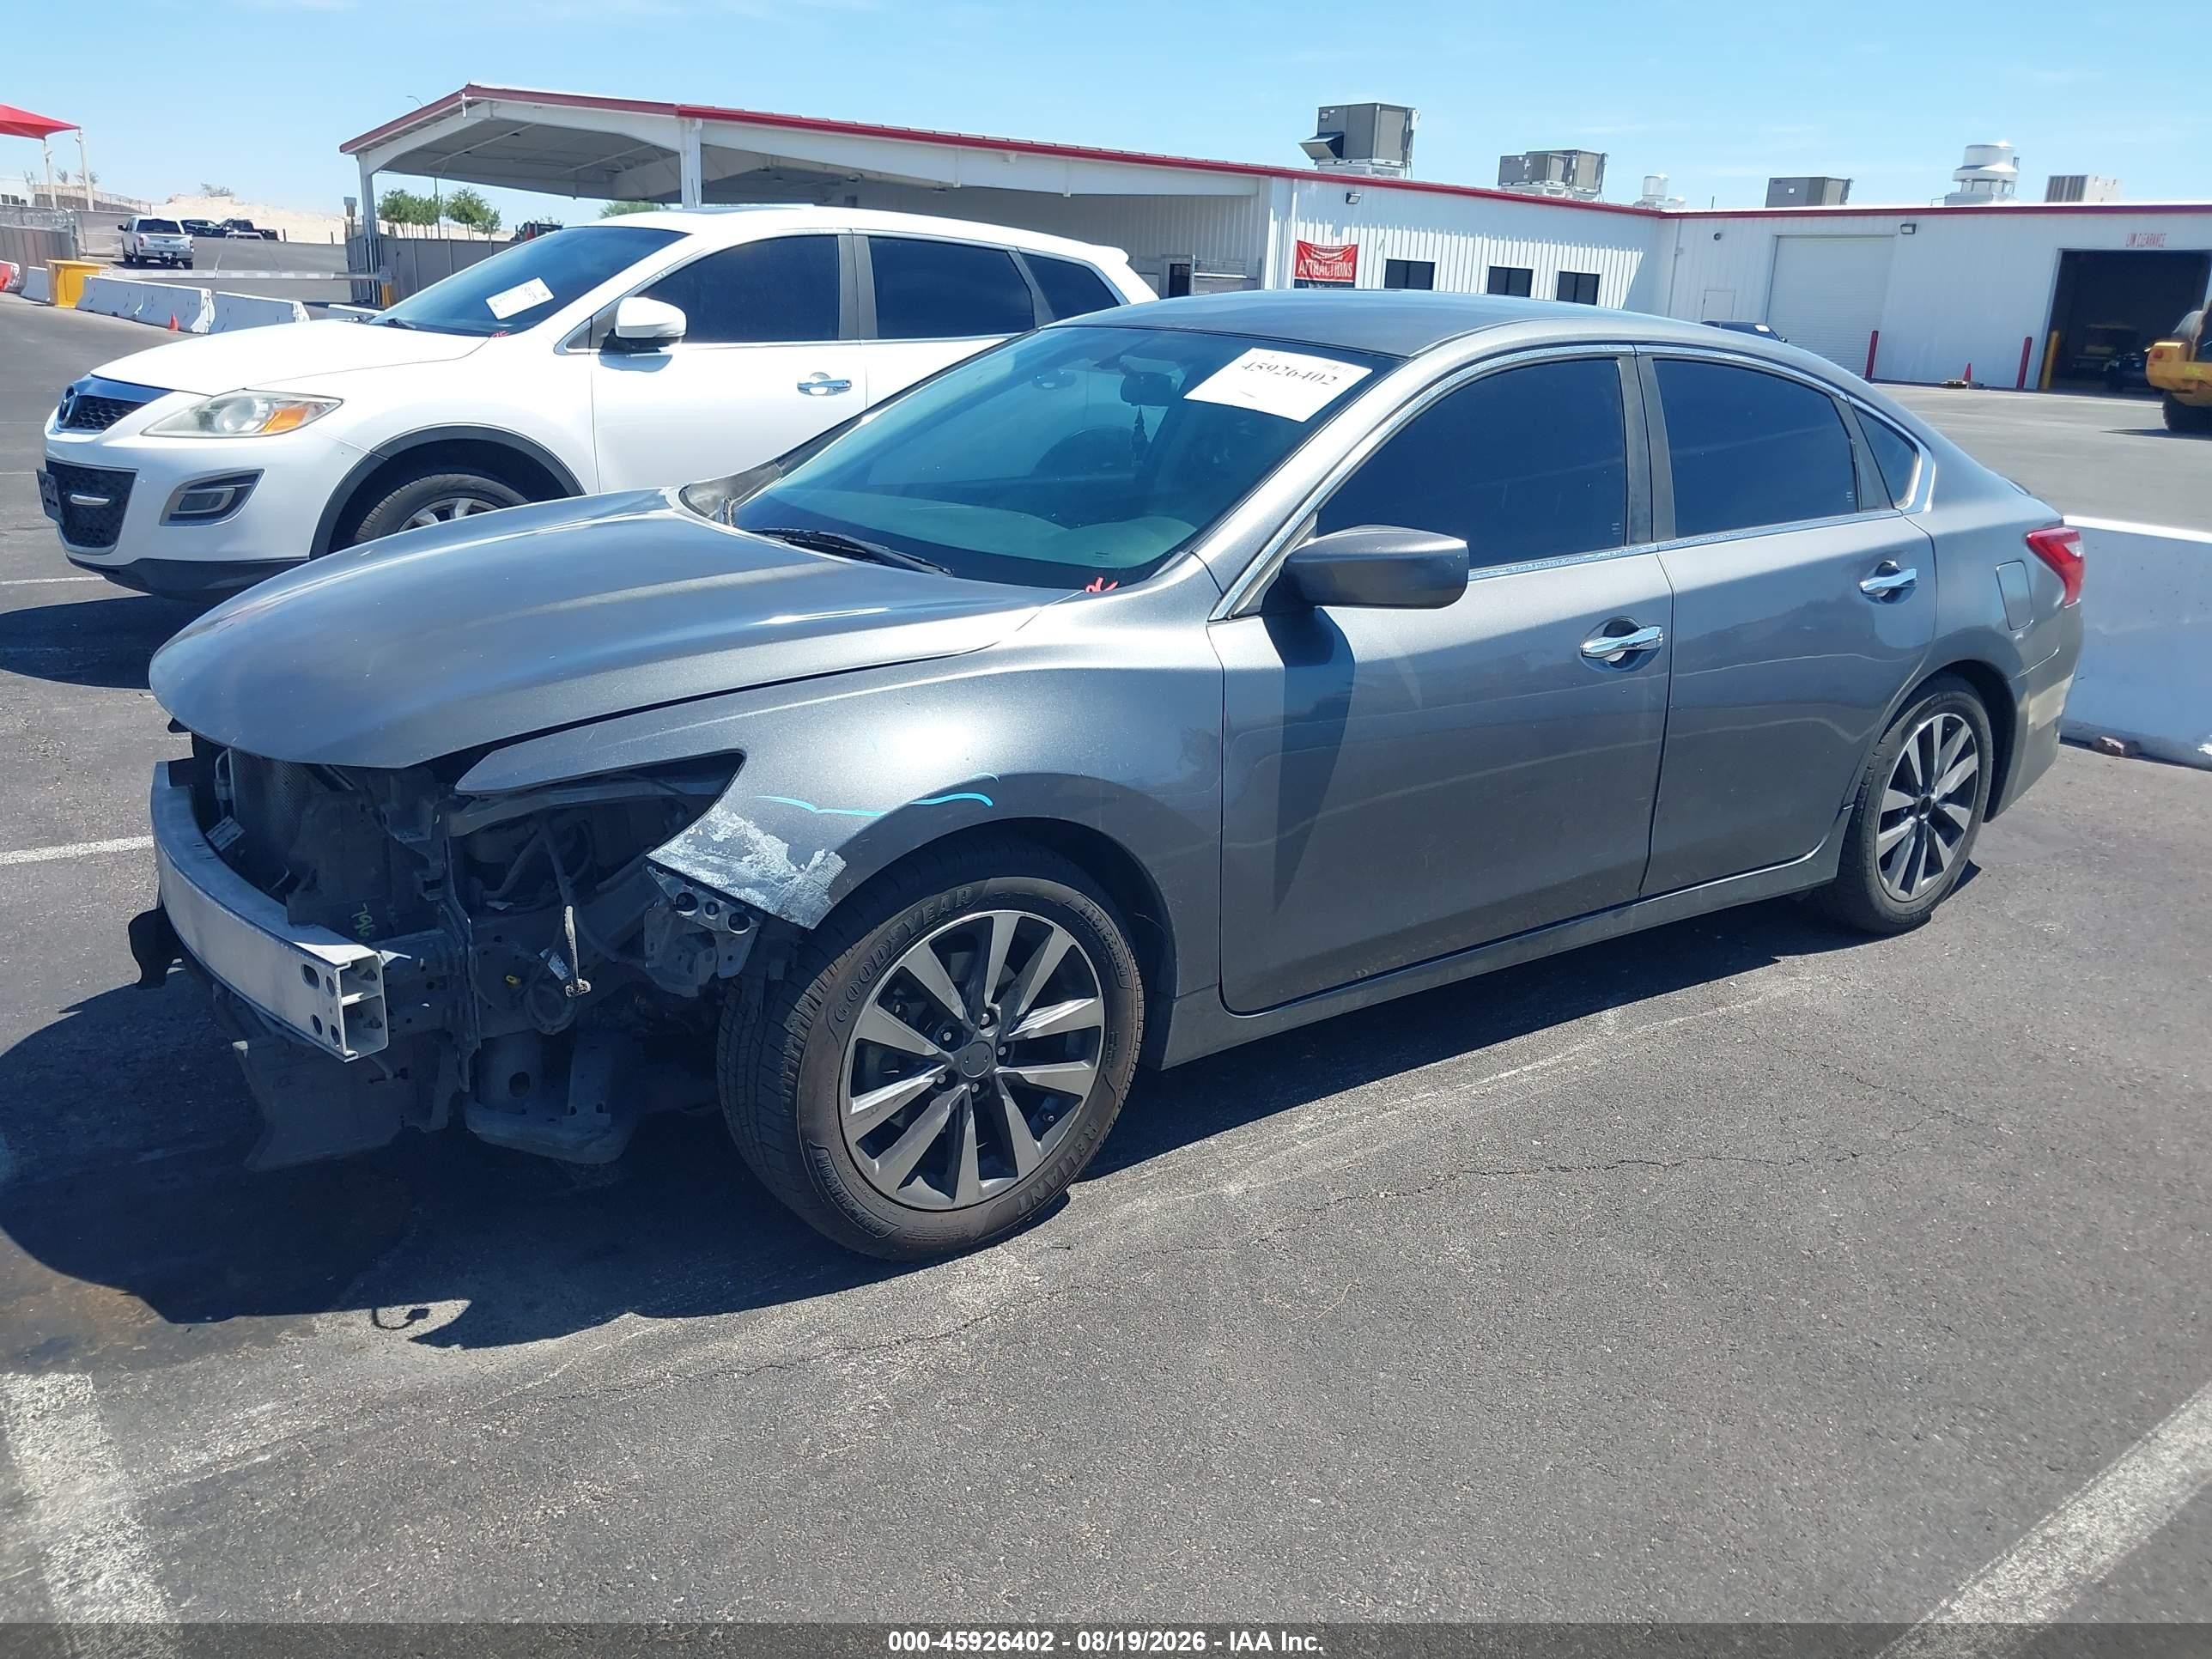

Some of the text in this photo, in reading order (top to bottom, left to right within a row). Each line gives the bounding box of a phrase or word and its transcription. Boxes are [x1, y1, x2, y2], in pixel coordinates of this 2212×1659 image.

[1298, 259, 1353, 277] ATTRACTIONS
[1242, 362, 1338, 386] 45926402
[835, 886, 972, 1022] GOODYEAR
[1017, 1119, 1100, 1215] RELIANT
